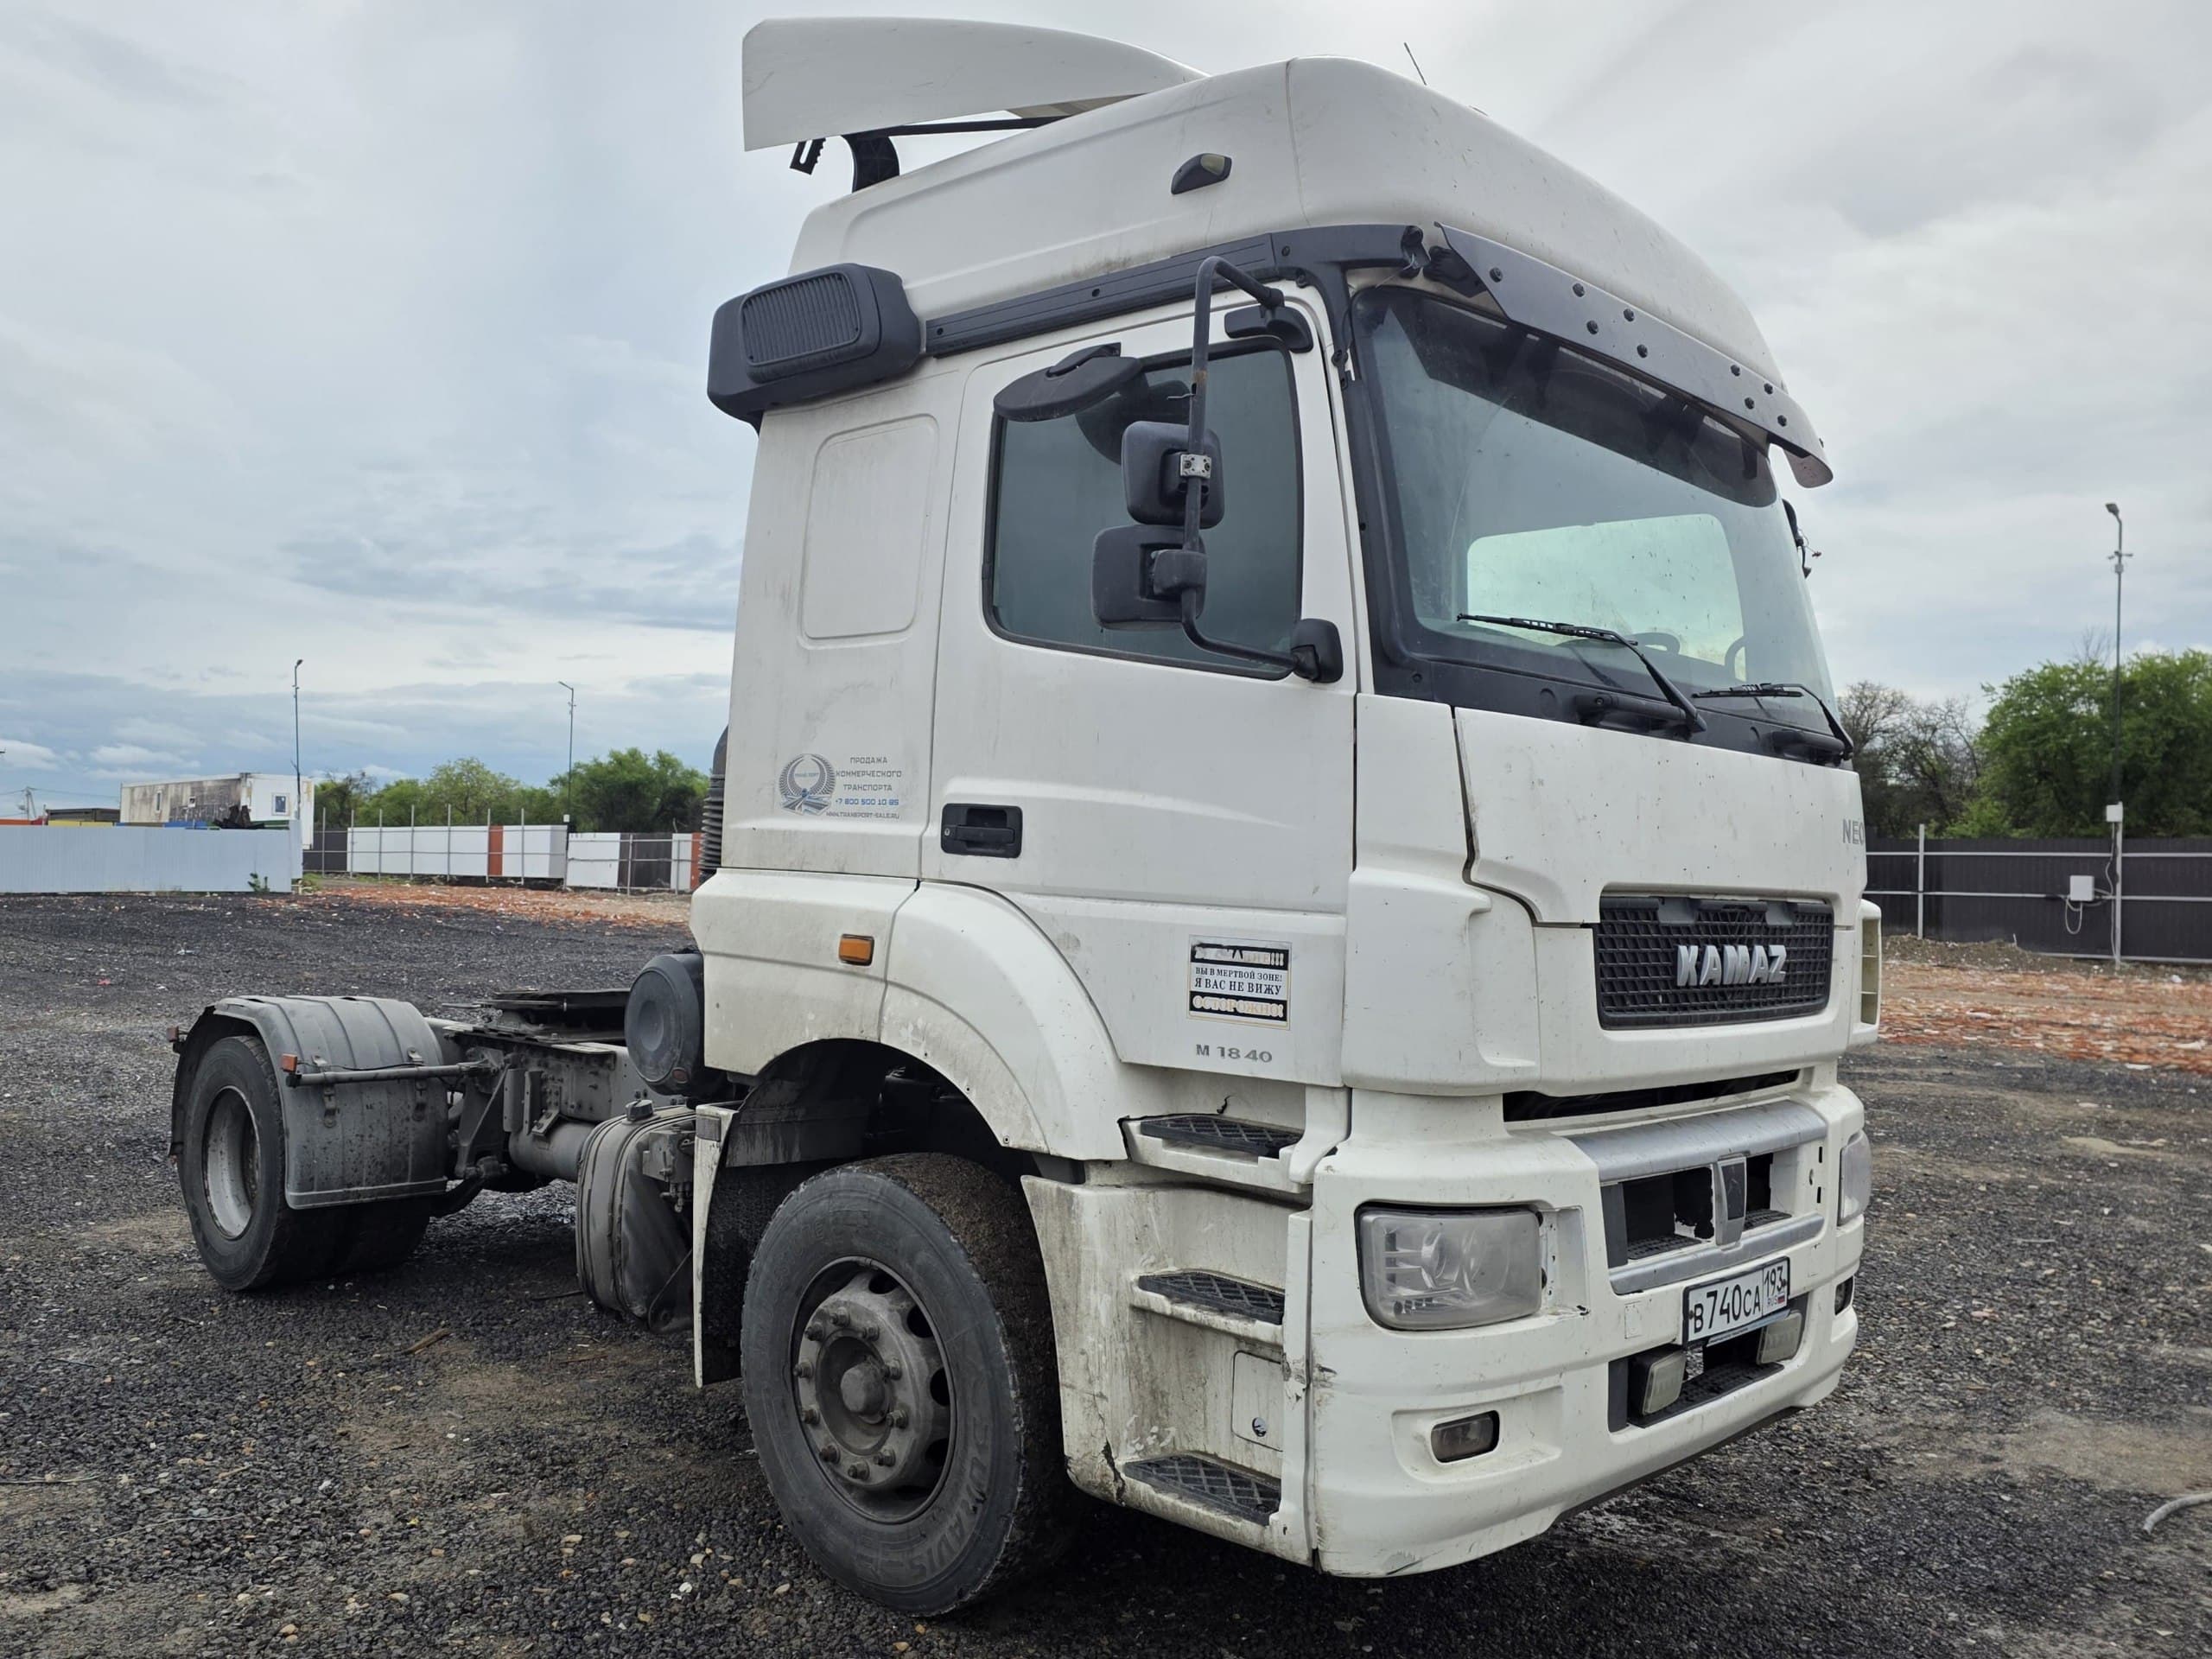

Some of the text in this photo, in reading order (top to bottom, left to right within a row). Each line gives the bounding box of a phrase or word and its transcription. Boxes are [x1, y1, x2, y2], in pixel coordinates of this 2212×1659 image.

[1842, 819, 1865, 846] NEO
[1195, 967, 1208, 976] ВЫ
[1217, 969, 1255, 980] МЕРТВОЙ
[1257, 973, 1282, 982] ЗОНЕ!
[1676, 944, 1787, 987] KAMAZ
[1194, 977, 1282, 995] Я ВАС НЕ ВИЖУ
[1196, 1044, 1273, 1063] M 1840
[1764, 1265, 1783, 1297] 193
